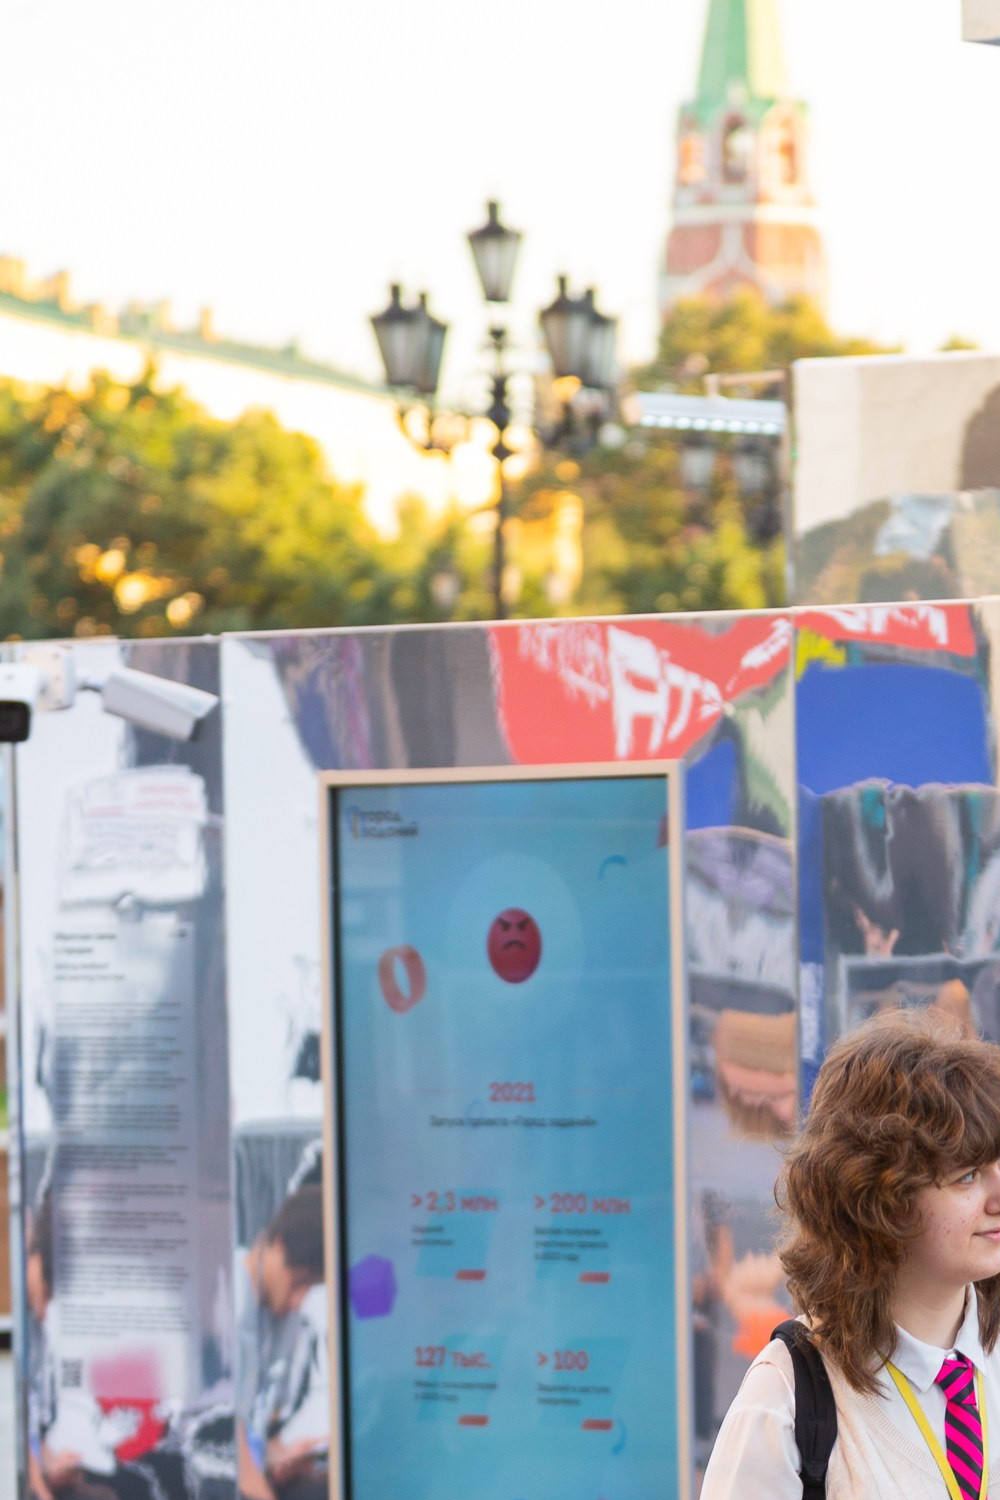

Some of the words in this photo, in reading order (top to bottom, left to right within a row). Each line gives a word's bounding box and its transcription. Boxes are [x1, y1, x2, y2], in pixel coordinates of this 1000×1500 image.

[489, 1081, 536, 1102] 2021
[427, 1190, 456, 1213] 2,3
[461, 1195, 498, 1212] млн
[550, 1192, 587, 1213] 200
[592, 1197, 630, 1214] млн
[415, 1346, 446, 1367] 127
[553, 1350, 589, 1371] 100
